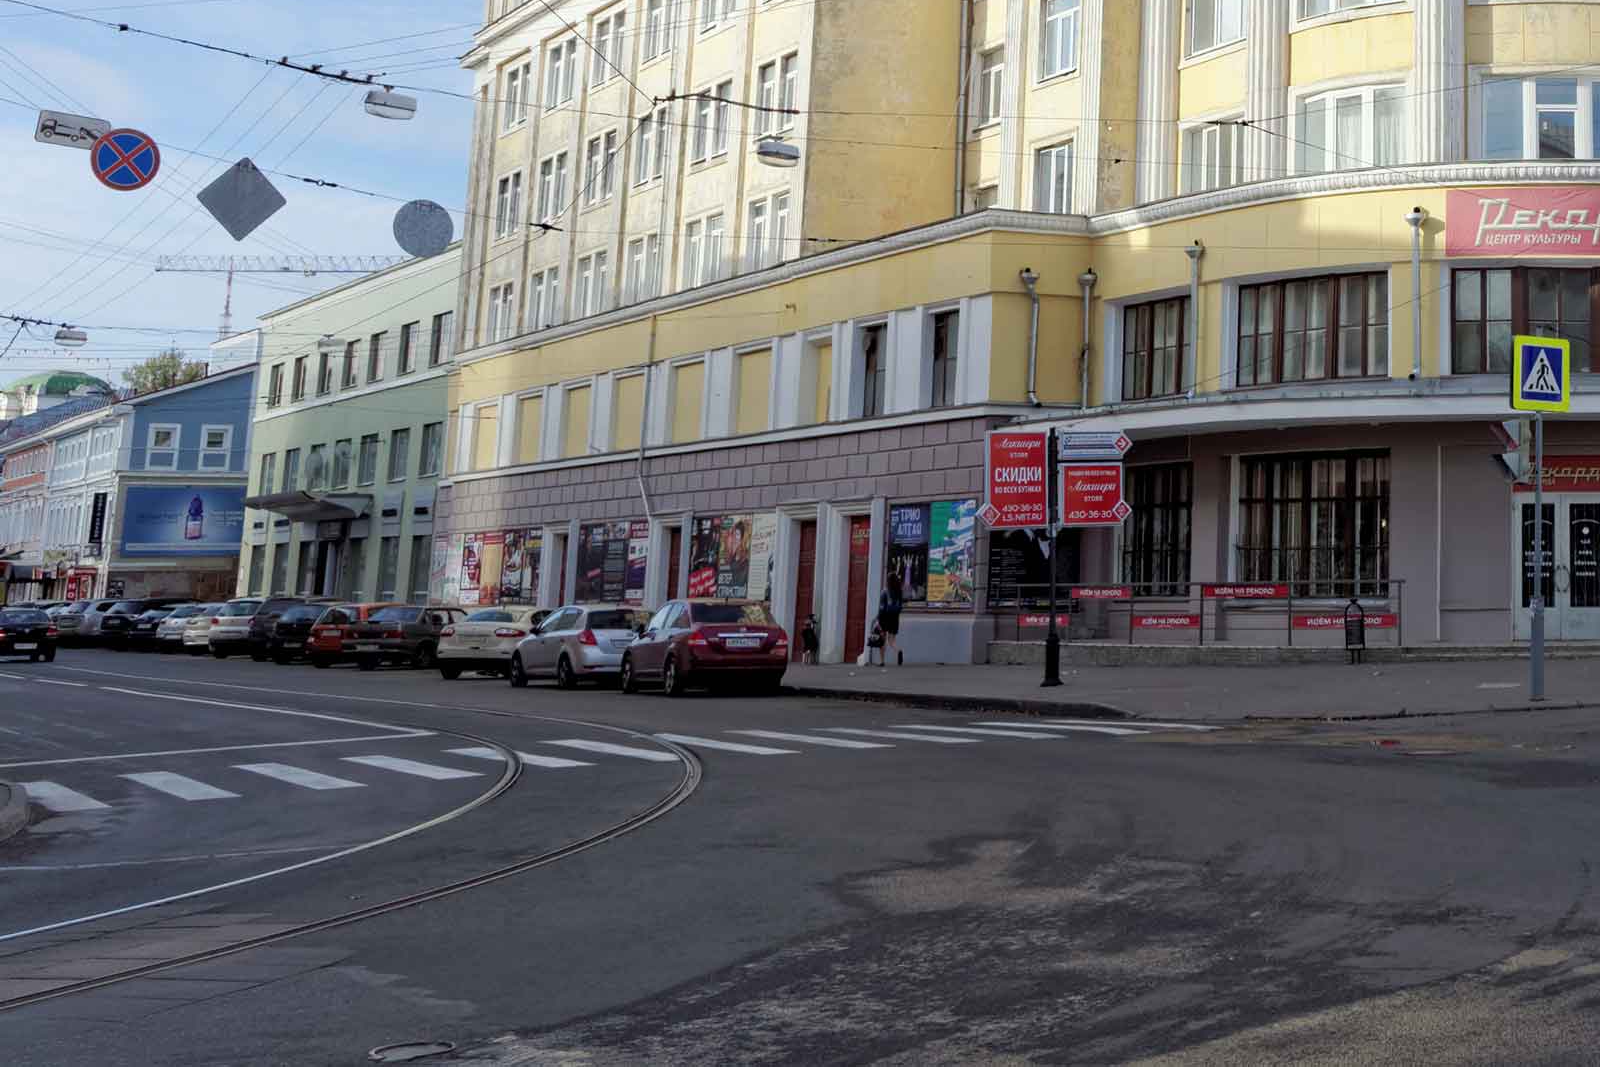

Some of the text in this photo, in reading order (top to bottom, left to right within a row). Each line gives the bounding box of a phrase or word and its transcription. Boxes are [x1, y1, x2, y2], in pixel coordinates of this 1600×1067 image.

[1485, 234, 1582, 246] ЦЕНТР КУЛЬТУРЫ
[994, 466, 1042, 484] СКИДКИ
[1307, 618, 1331, 626] ИДЁМ
